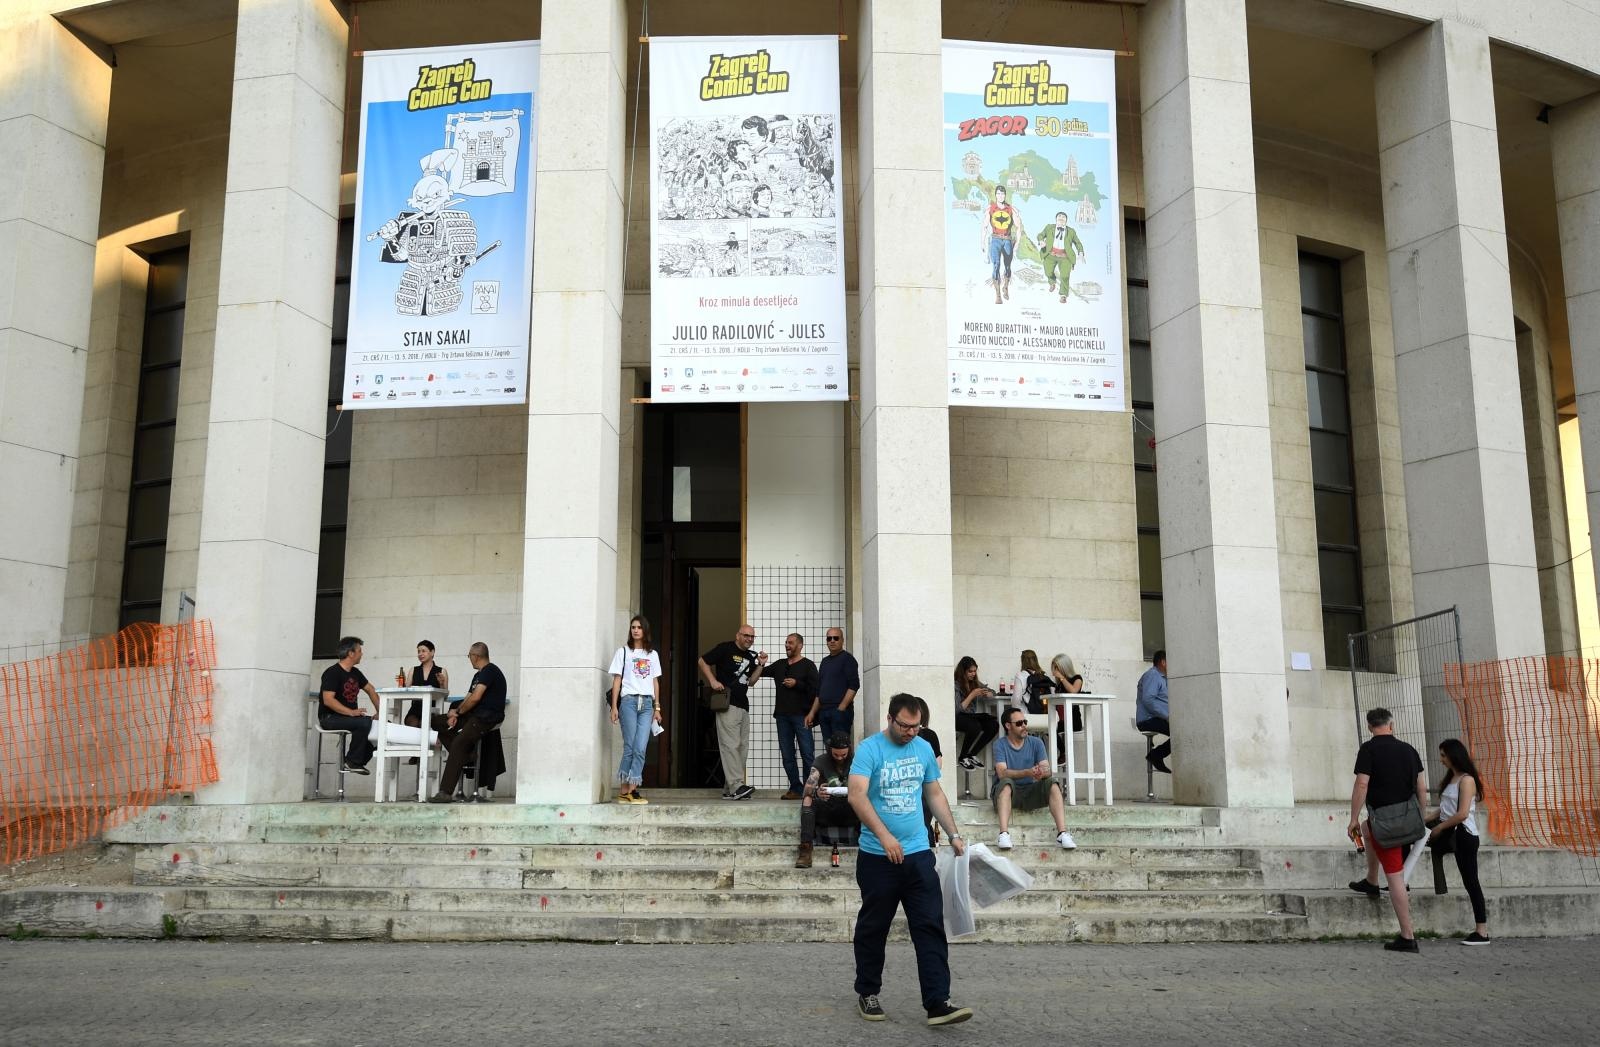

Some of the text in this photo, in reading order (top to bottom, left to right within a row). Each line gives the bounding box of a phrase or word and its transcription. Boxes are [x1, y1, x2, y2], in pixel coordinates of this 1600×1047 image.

[418, 59, 475, 90] Zagreb
[709, 51, 770, 79] Zagreb
[993, 62, 1050, 87] Zagreb
[408, 80, 491, 110] Comic Con
[701, 72, 788, 100] Comic Con
[985, 83, 1068, 106] Comic Con
[958, 116, 1088, 141] ZAGOR 50 godina
[699, 294, 798, 308] Kroz minula desetljeća
[404, 329, 470, 346] STAN SAKAI
[672, 325, 708, 340] JULIO
[712, 320, 774, 340] RADILOVIĆ
[788, 324, 826, 338] JULES
[964, 321, 1098, 337] MORENO BURATTINI MAURO LAURENTI
[812, 346, 828, 354] Zagreb
[958, 334, 1106, 350] JOEVITO NUCCIO ALESSANDRO PICCINELLI
[880, 763, 924, 788] RACER
